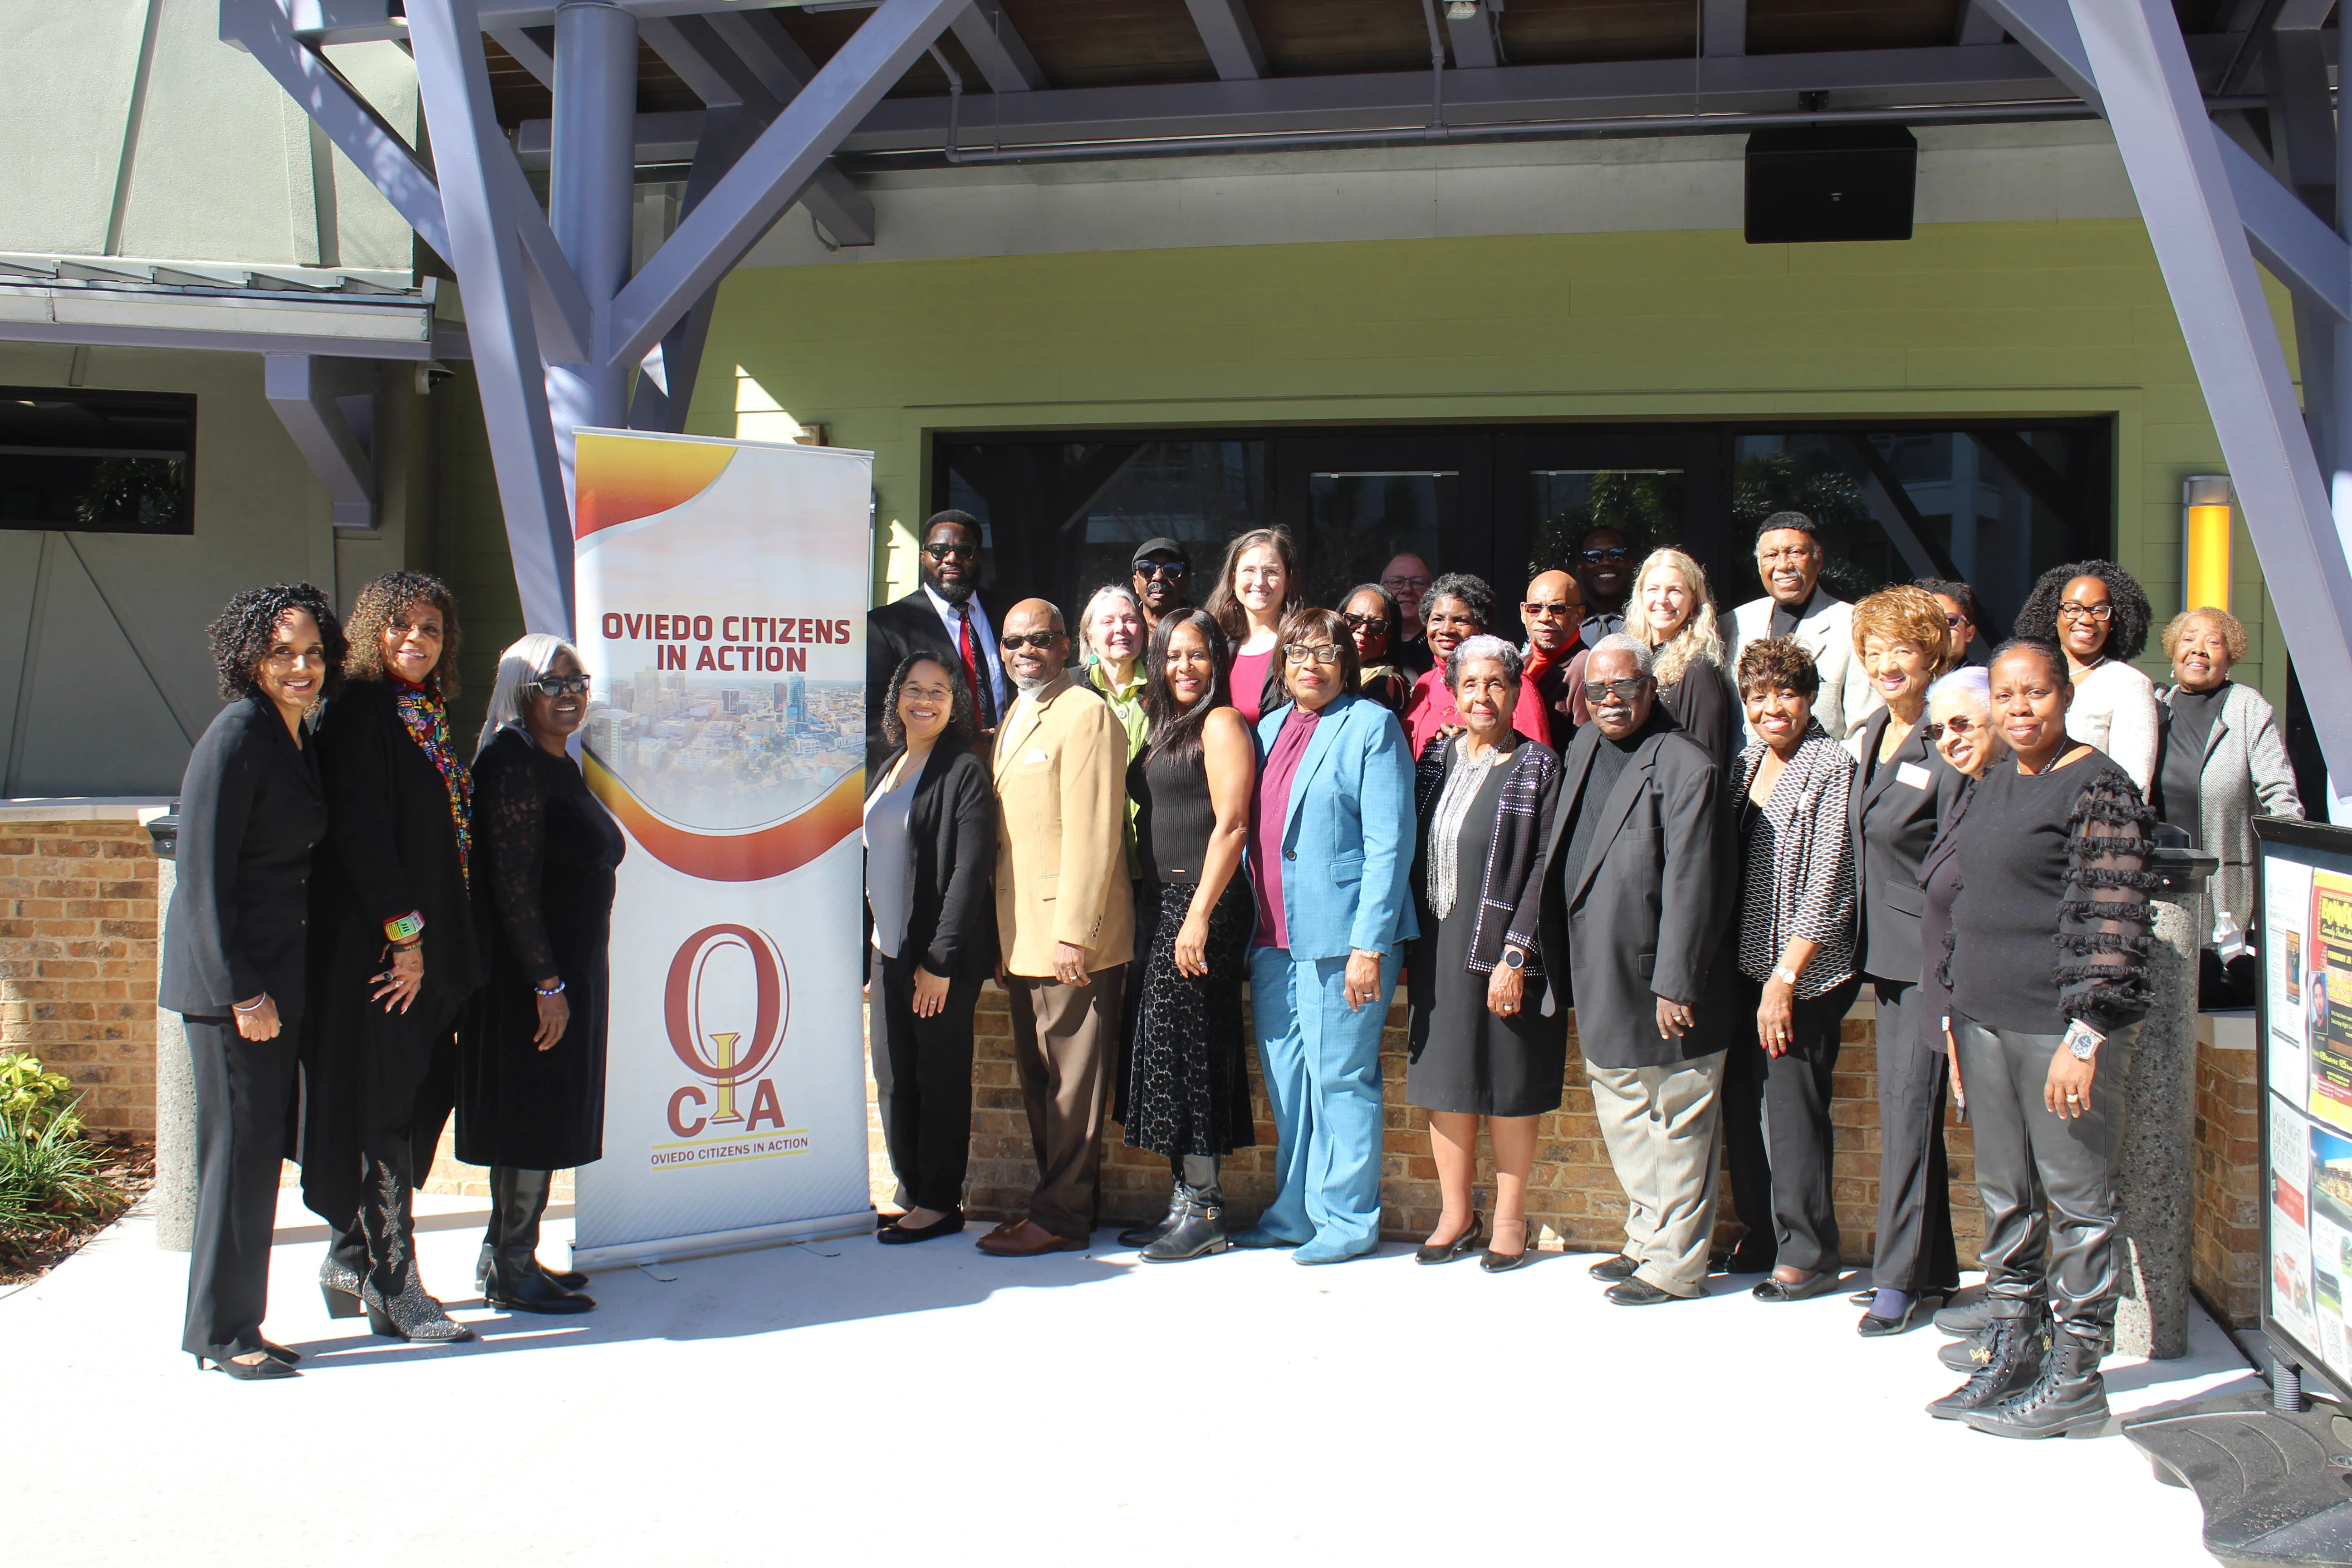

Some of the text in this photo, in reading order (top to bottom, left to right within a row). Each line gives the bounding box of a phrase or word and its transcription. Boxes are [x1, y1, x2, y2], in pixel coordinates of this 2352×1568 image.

[603, 612, 851, 645] OVIEDO CITIZENS
[658, 644, 807, 672] IN ACTION
[2328, 950, 2346, 963] FEBRUARY
[651, 1137, 808, 1165] OVIEDO CITIZENS IN ACTION
